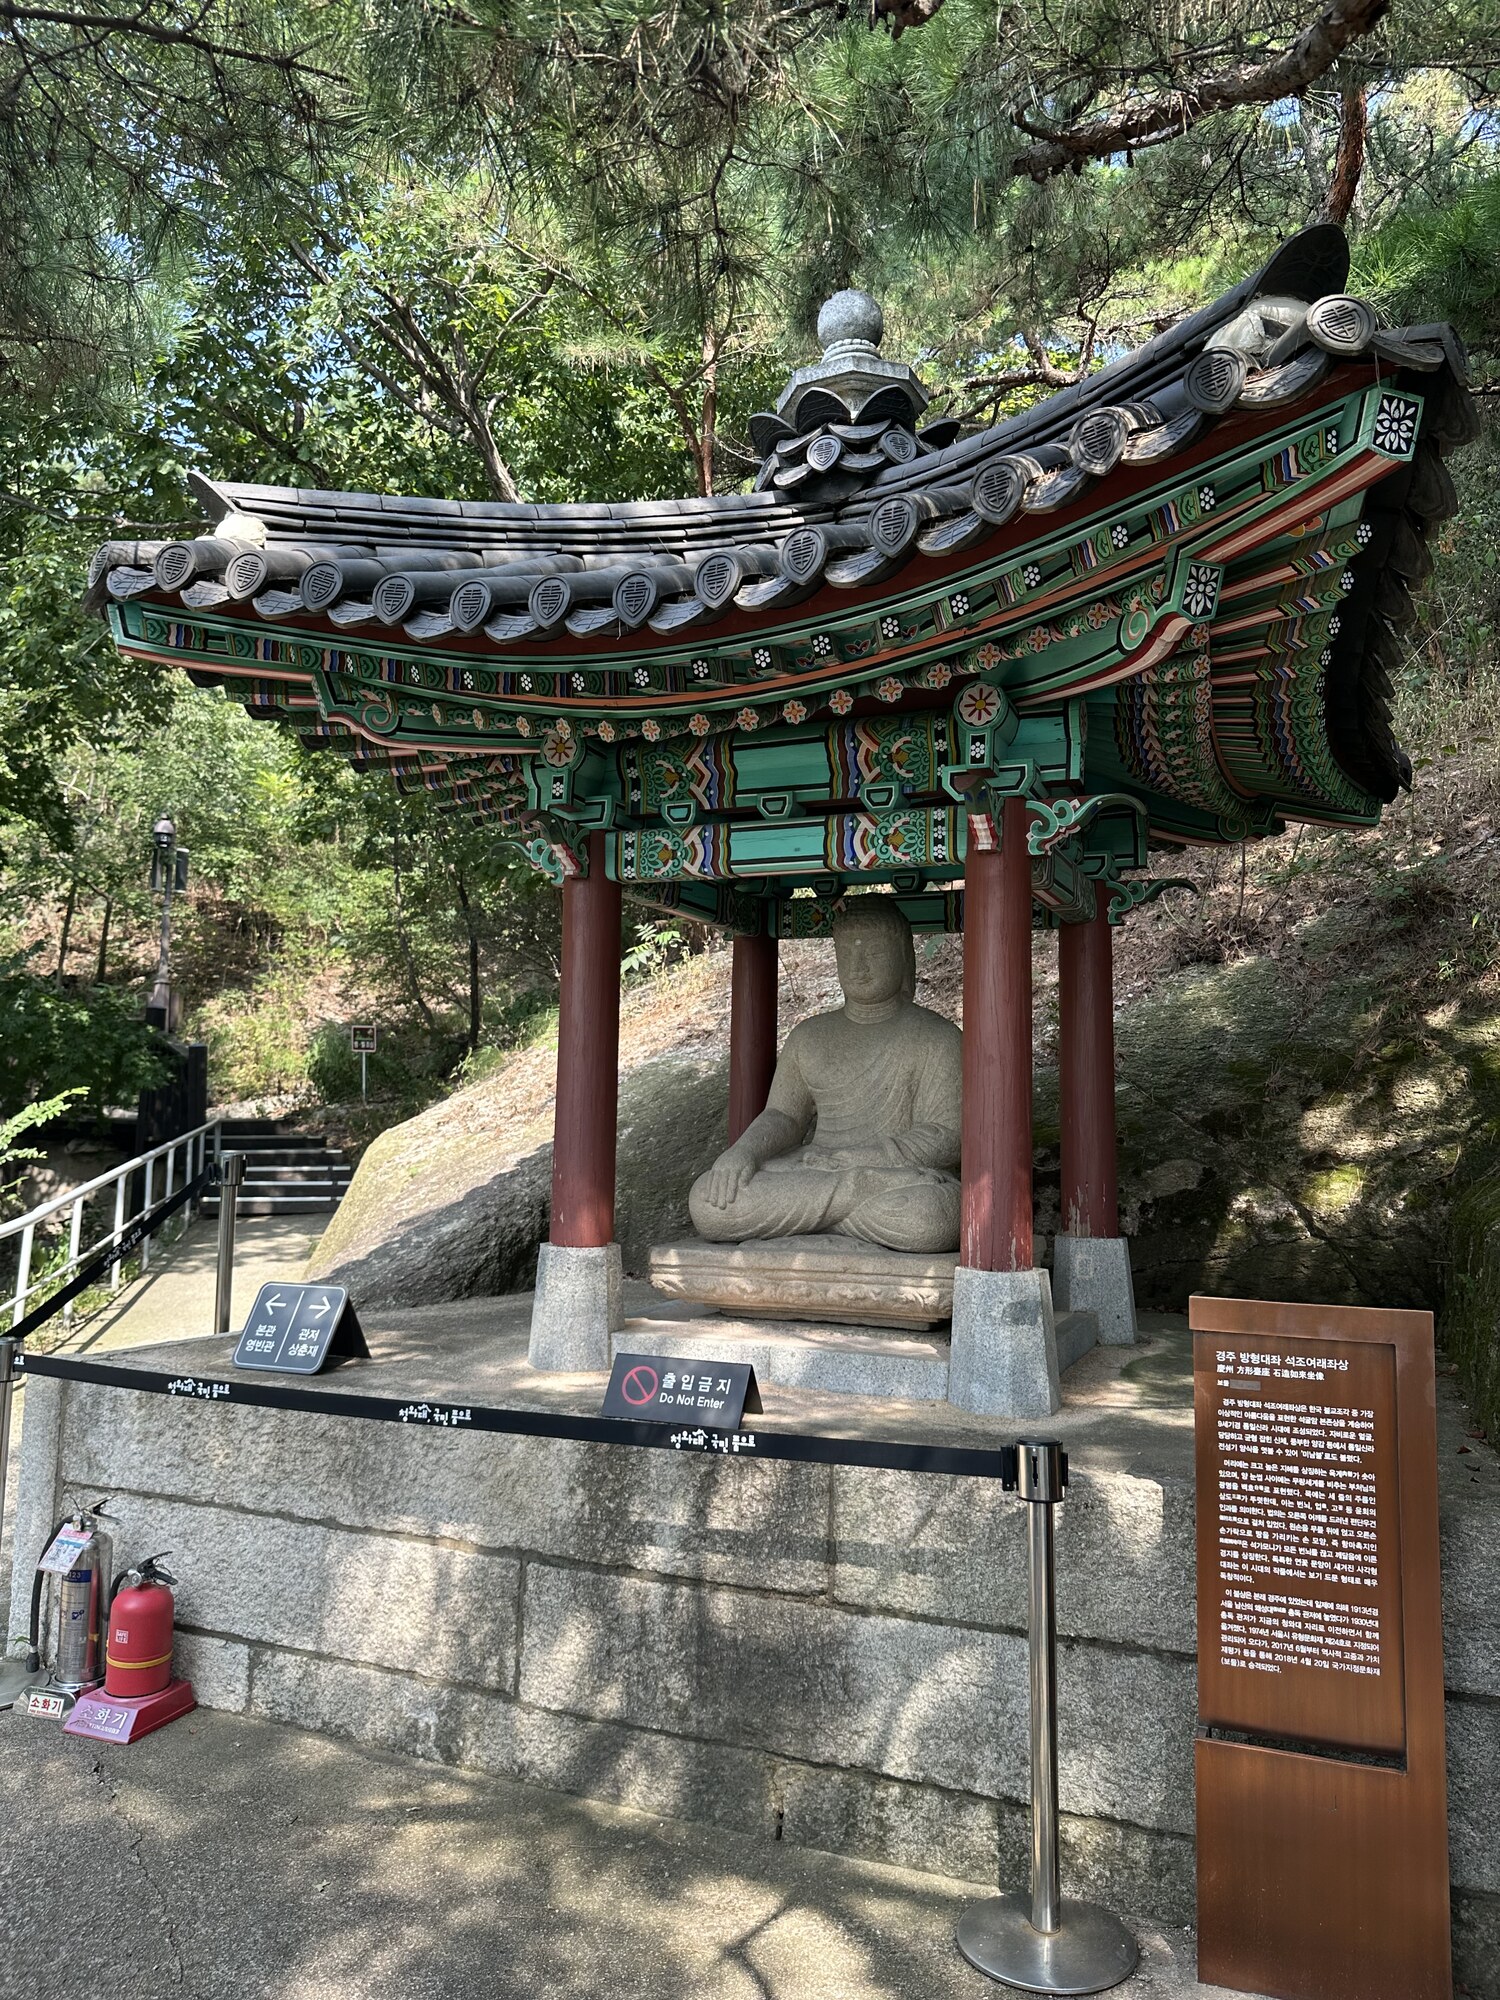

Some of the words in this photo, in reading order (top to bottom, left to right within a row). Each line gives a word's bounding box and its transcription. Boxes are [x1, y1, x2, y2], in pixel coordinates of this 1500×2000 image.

[255, 1324, 276, 1337] 본관
[298, 1328, 320, 1341] 관저
[245, 1339, 275, 1353] 영빈관
[288, 1343, 319, 1357] 상춘재
[1215, 1350, 1236, 1362] 경주
[1239, 1352, 1281, 1365] 방형대좌
[1284, 1355, 1348, 1370] 석조여래좌상
[1216, 1363, 1233, 1373] 慶州
[1236, 1365, 1270, 1376] 方形臺座
[1272, 1368, 1324, 1380] 石造如來坐像
[197, 1383, 210, 1399] 국민
[212, 1384, 230, 1398] 품으로
[659, 1392, 673, 1404] Do
[676, 1395, 694, 1406] Not
[697, 1396, 725, 1409] Enter
[433, 1408, 448, 1426] 국민
[451, 1409, 472, 1425] 품으로
[711, 1434, 729, 1453] 국민
[732, 1435, 756, 1451] 품으로
[1275, 1447, 1283, 1455] 수
[1240, 1471, 1248, 1480] 양
[1327, 1492, 1335, 1500] 세
[1301, 1535, 1309, 1543] 손
[1331, 1538, 1338, 1547] 즉
[1241, 1563, 1248, 1571] 이
[1225, 1588, 1232, 1597] 이
[30, 1697, 61, 1713] 소화기
[77, 1704, 128, 1729] 소화기
